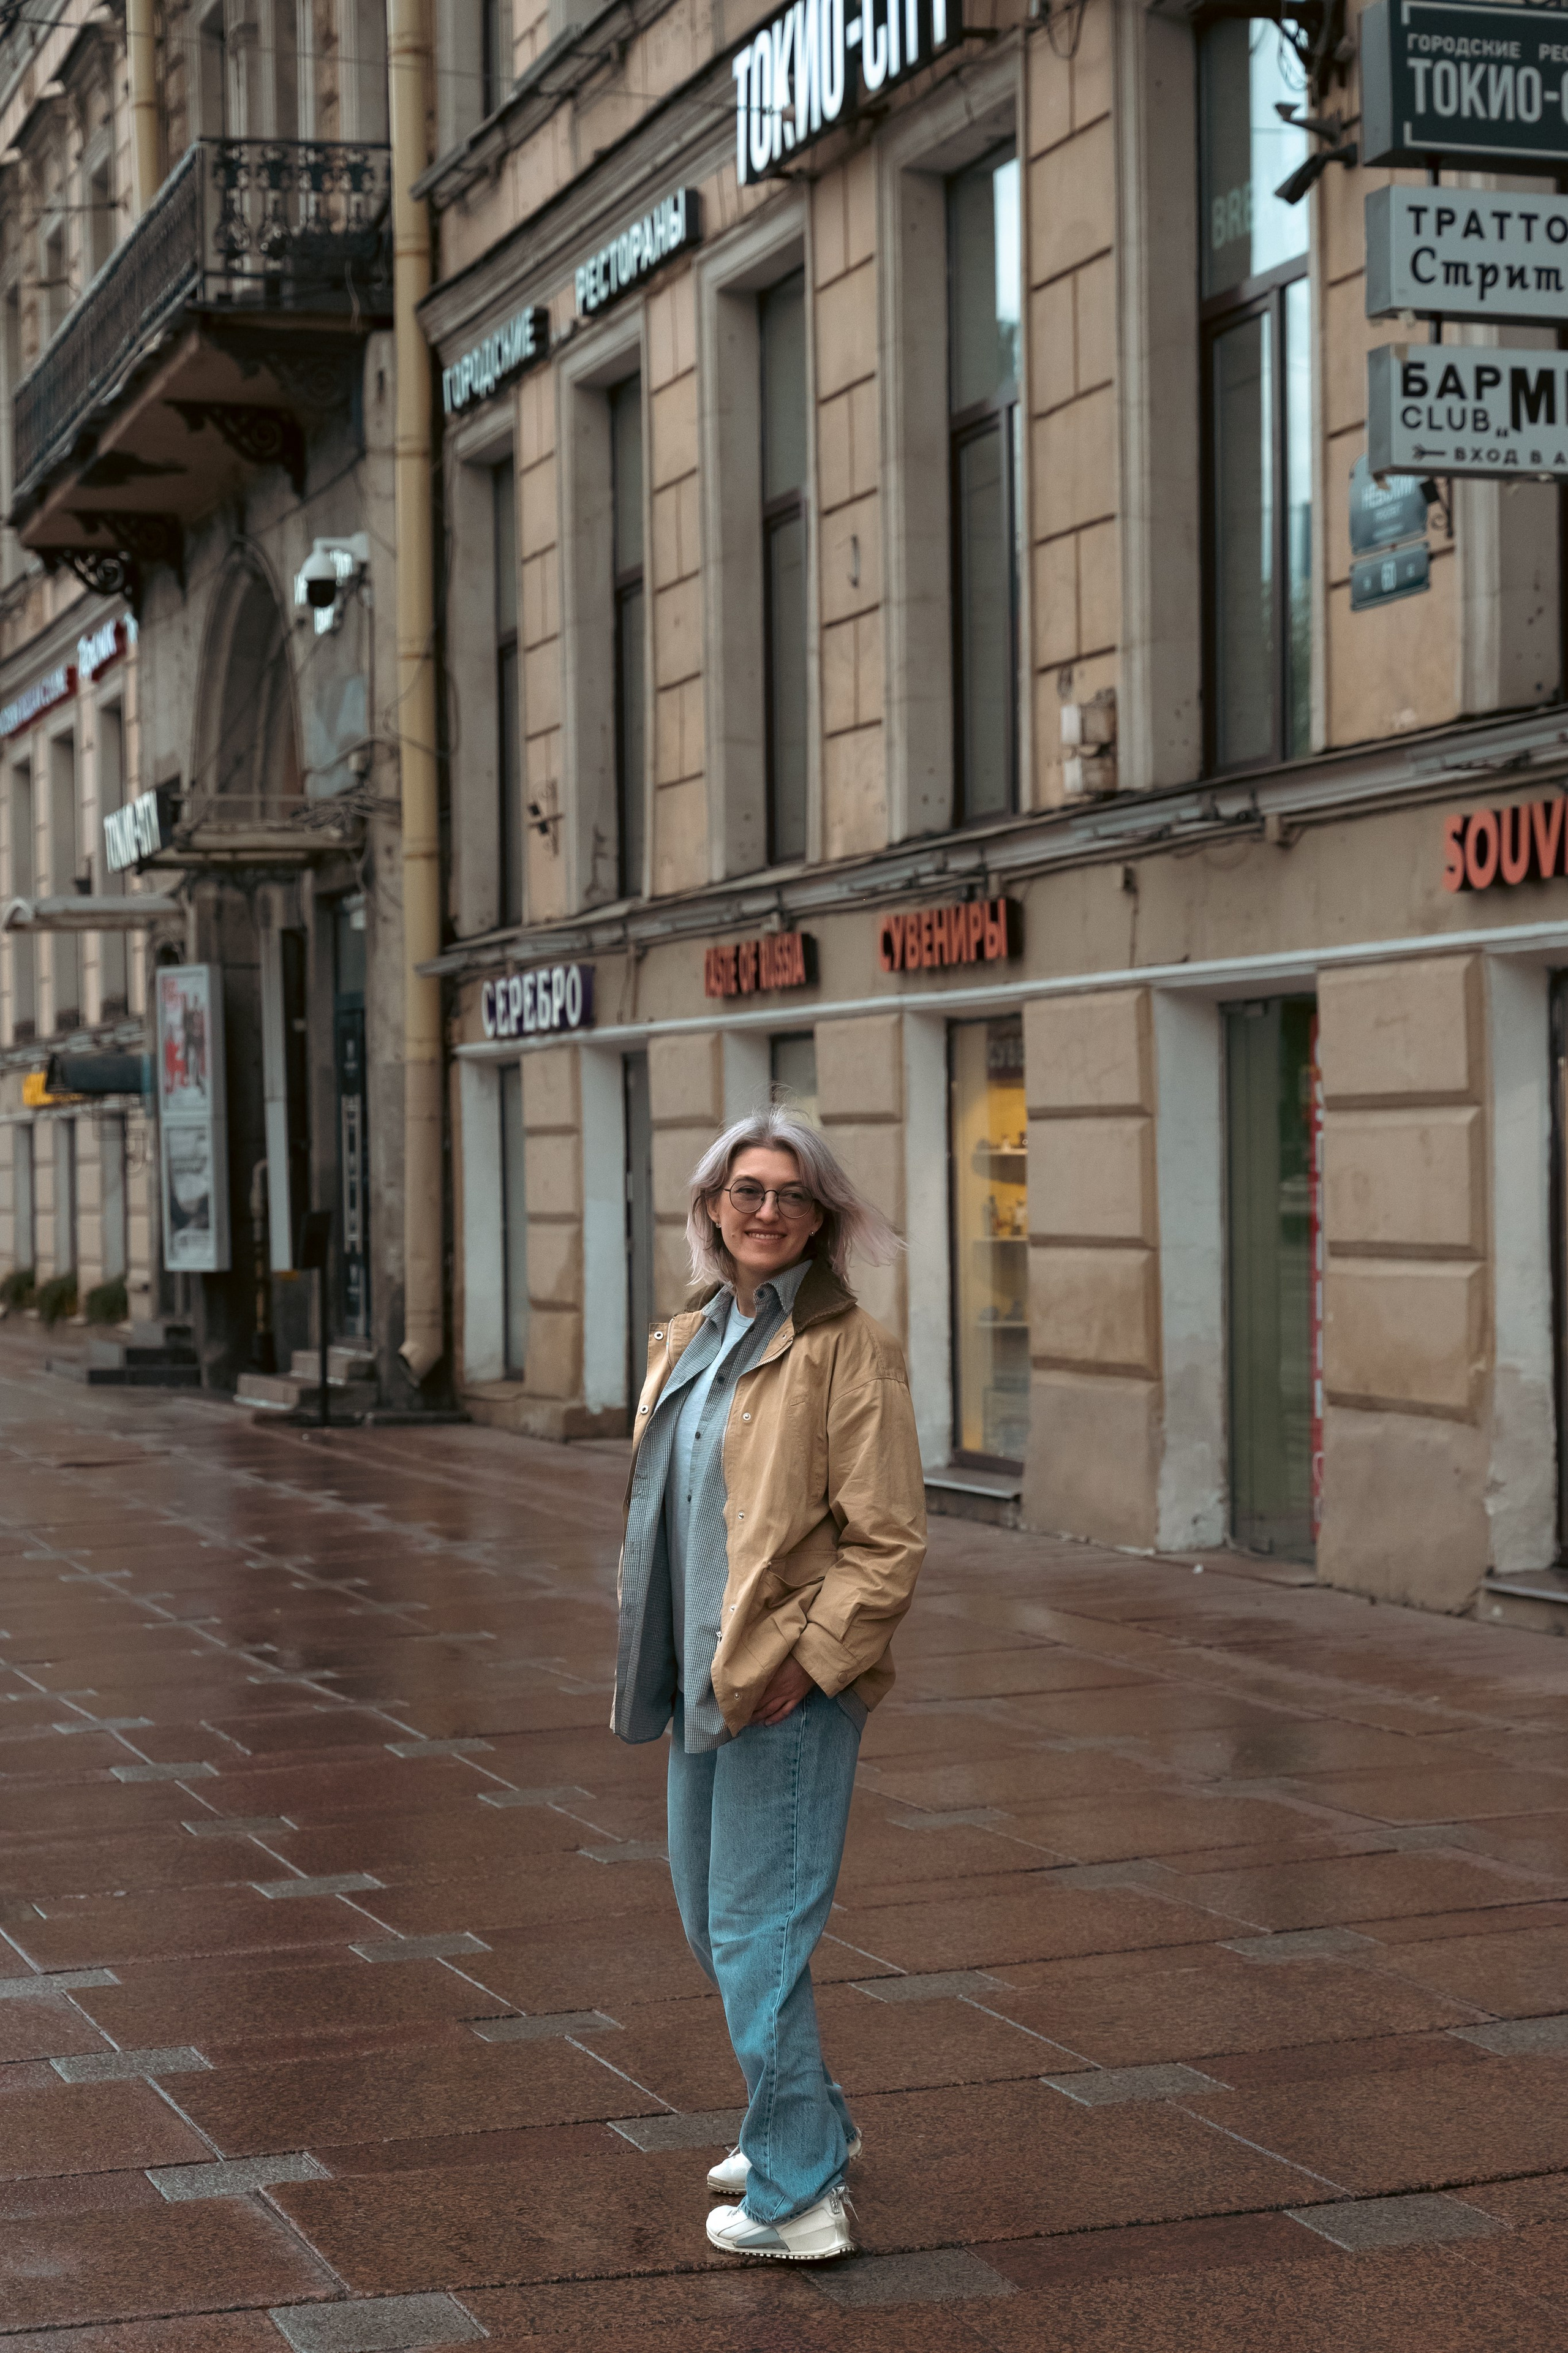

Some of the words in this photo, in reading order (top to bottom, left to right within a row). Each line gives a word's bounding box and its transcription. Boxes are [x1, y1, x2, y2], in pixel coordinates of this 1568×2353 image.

[1408, 33, 1521, 59] ГОРОДСКИЕ
[733, 0, 947, 186] ТОКИО-C
[1407, 57, 1568, 125] ТОКИО-
[575, 186, 687, 315] РЕСТОРАНЫ
[1407, 205, 1568, 244] ТРАТТО
[1411, 246, 1564, 300] Стрит
[443, 306, 537, 414] ГОРОДСКИЕ
[1401, 362, 1501, 401] БАР
[1401, 406, 1490, 431] CLUB
[1455, 445, 1518, 466] ВХОД
[1530, 449, 1543, 464] В
[1442, 794, 1568, 894] SOUV
[880, 899, 1008, 972] СУВЕНИРЫ
[481, 962, 582, 1039] СЕРЕБРО
